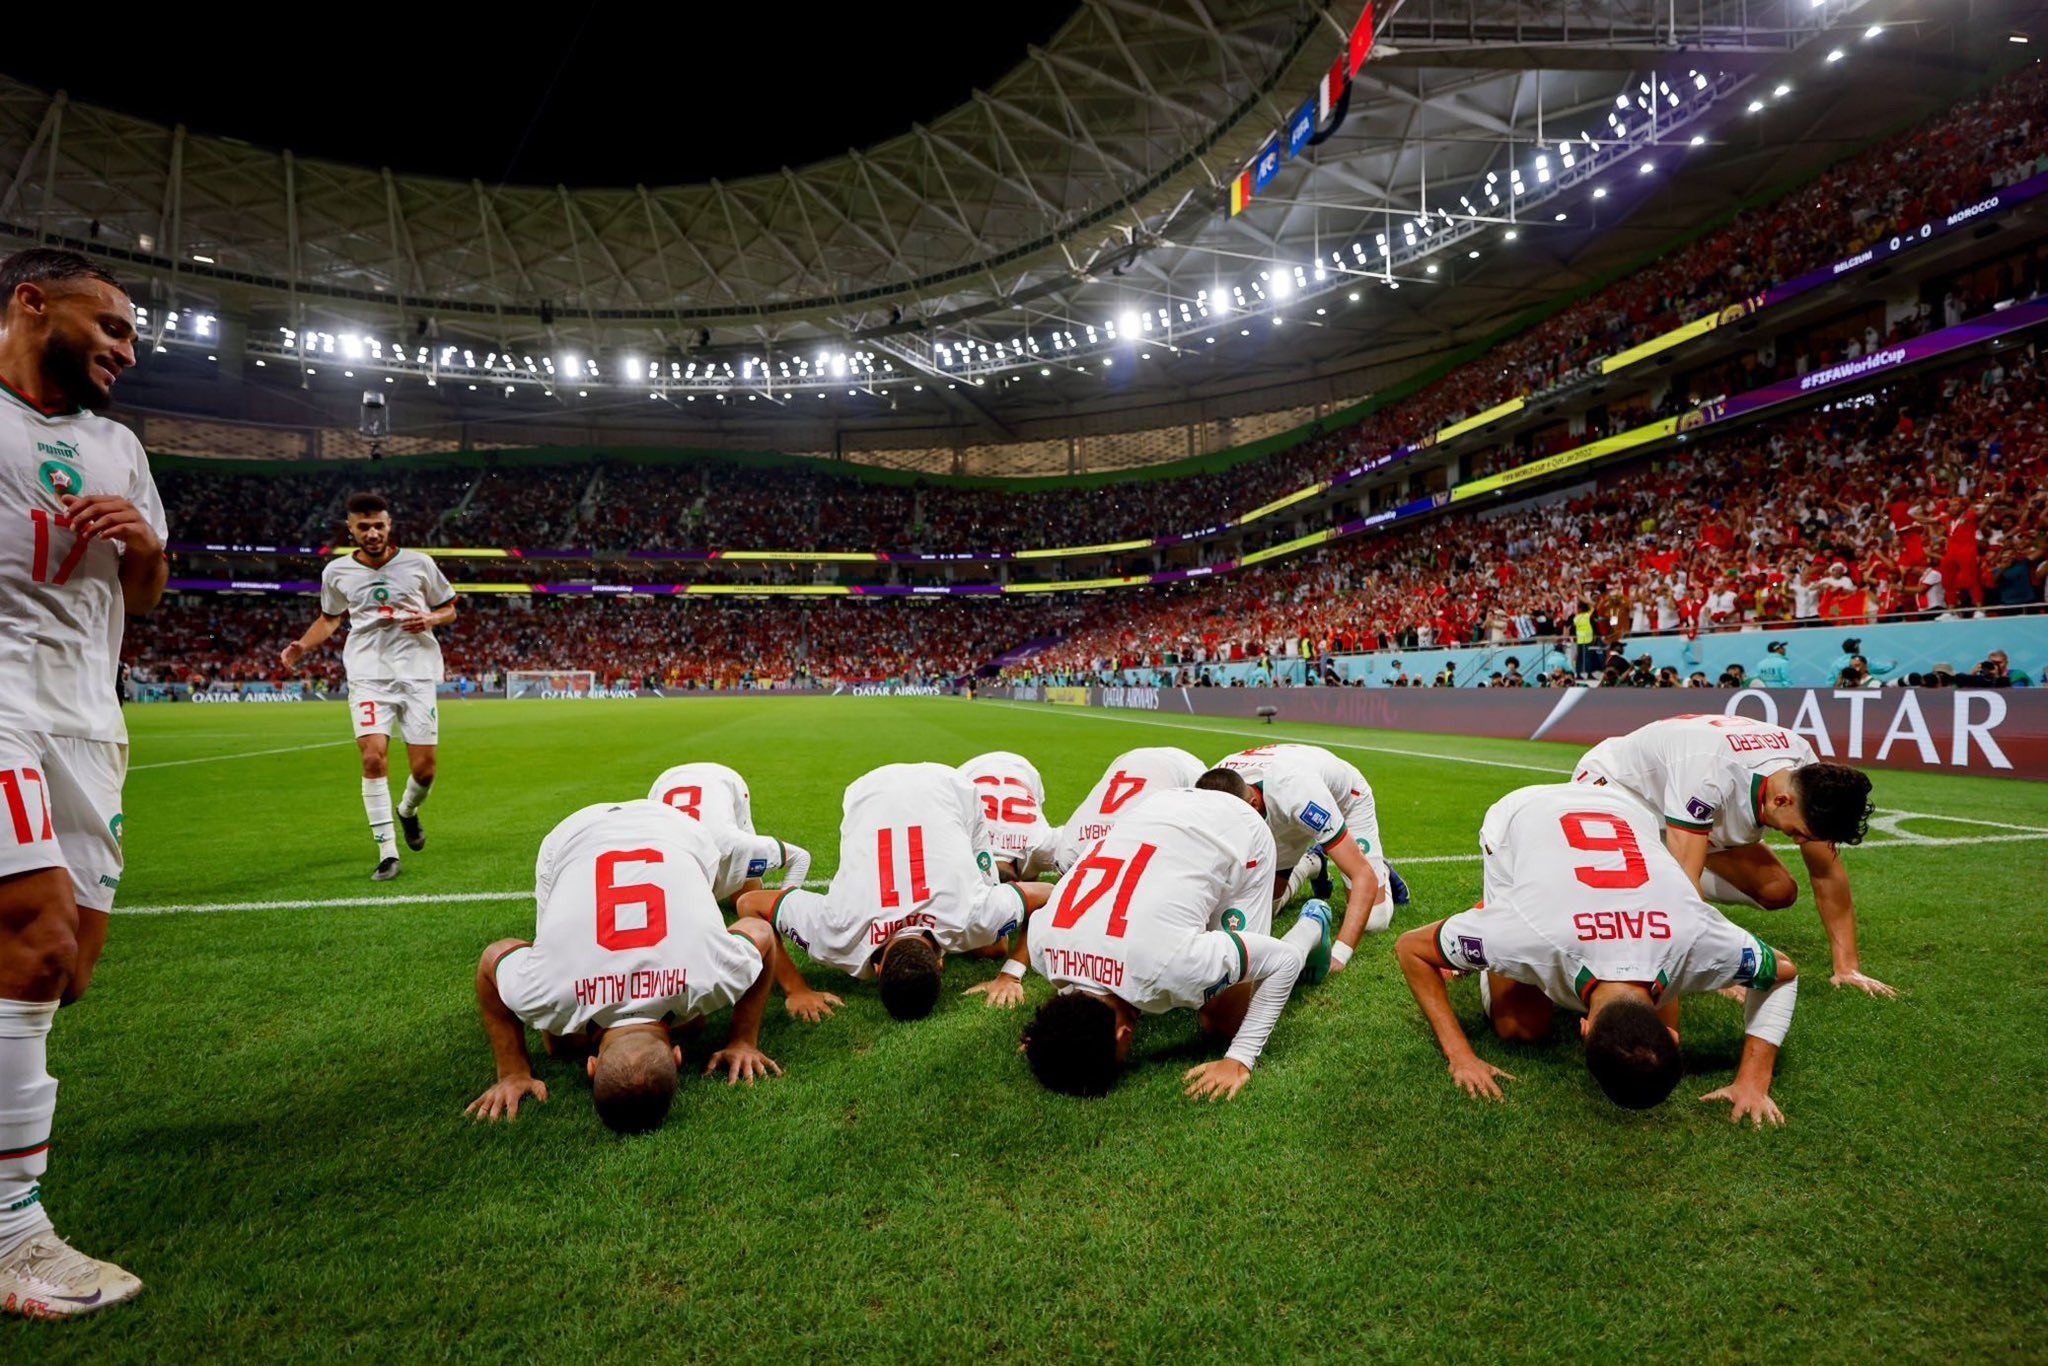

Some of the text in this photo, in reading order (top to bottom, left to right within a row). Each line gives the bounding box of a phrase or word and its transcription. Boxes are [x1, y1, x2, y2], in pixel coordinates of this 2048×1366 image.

[1833, 251, 1872, 274] BELGIUM
[1890, 237, 1900, 250] 0
[1921, 224, 1931, 237] 0
[1947, 197, 1999, 225] MOROCCO
[1800, 348, 1906, 389] #FIFAWorldCup
[37, 442, 74, 458] PUMA
[31, 508, 94, 585] 17
[191, 692, 303, 703] QATAR AIRWAYS
[360, 701, 376, 727] 3
[852, 686, 940, 696] QATAR AIRWAYS
[1103, 687, 1124, 707] QATAR
[1126, 687, 1159, 709] AIRWAYS
[1725, 688, 2013, 769] QATAR
[0, 767, 52, 845] 17
[973, 775, 1037, 824] 25
[1099, 770, 1147, 814] 4
[877, 825, 930, 907] 11
[1559, 812, 1649, 889] 6
[596, 848, 667, 951] 9
[1051, 842, 1158, 938] 14
[1573, 911, 1671, 941] SAISS
[575, 968, 687, 1006] HAMED ALLAH
